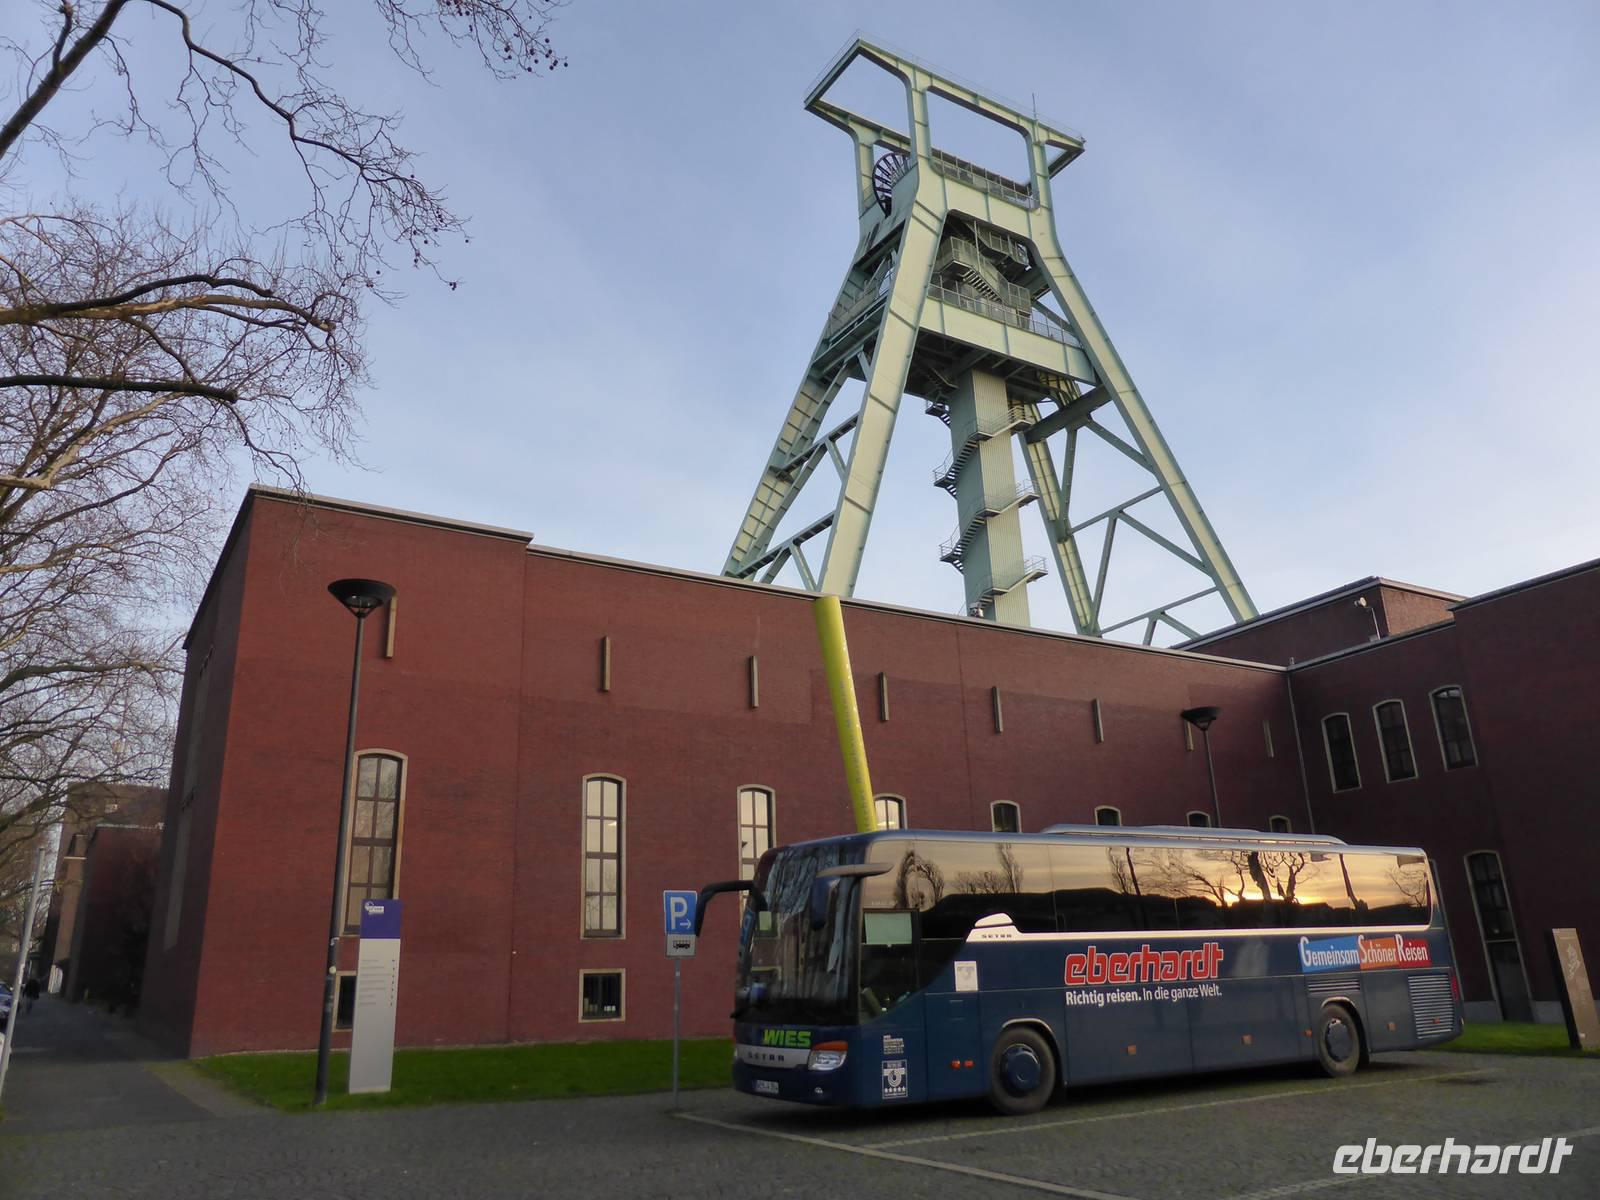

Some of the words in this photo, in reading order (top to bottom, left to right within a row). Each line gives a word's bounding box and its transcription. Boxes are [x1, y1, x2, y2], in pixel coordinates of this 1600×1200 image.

[670, 896, 688, 930] P
[1064, 942, 1224, 985] eberhardt
[1300, 936, 1360, 967] Gemeinsam
[1358, 934, 1397, 963] Schöner
[1395, 933, 1428, 961] Reisen
[1065, 989, 1105, 1007] Richtig
[1106, 988, 1142, 1003] reisen.
[1142, 987, 1153, 1001] In
[1154, 986, 1169, 1000] die
[1171, 987, 1199, 1002] ganze
[1198, 983, 1223, 997] Welt.
[763, 1029, 811, 1047] WIES
